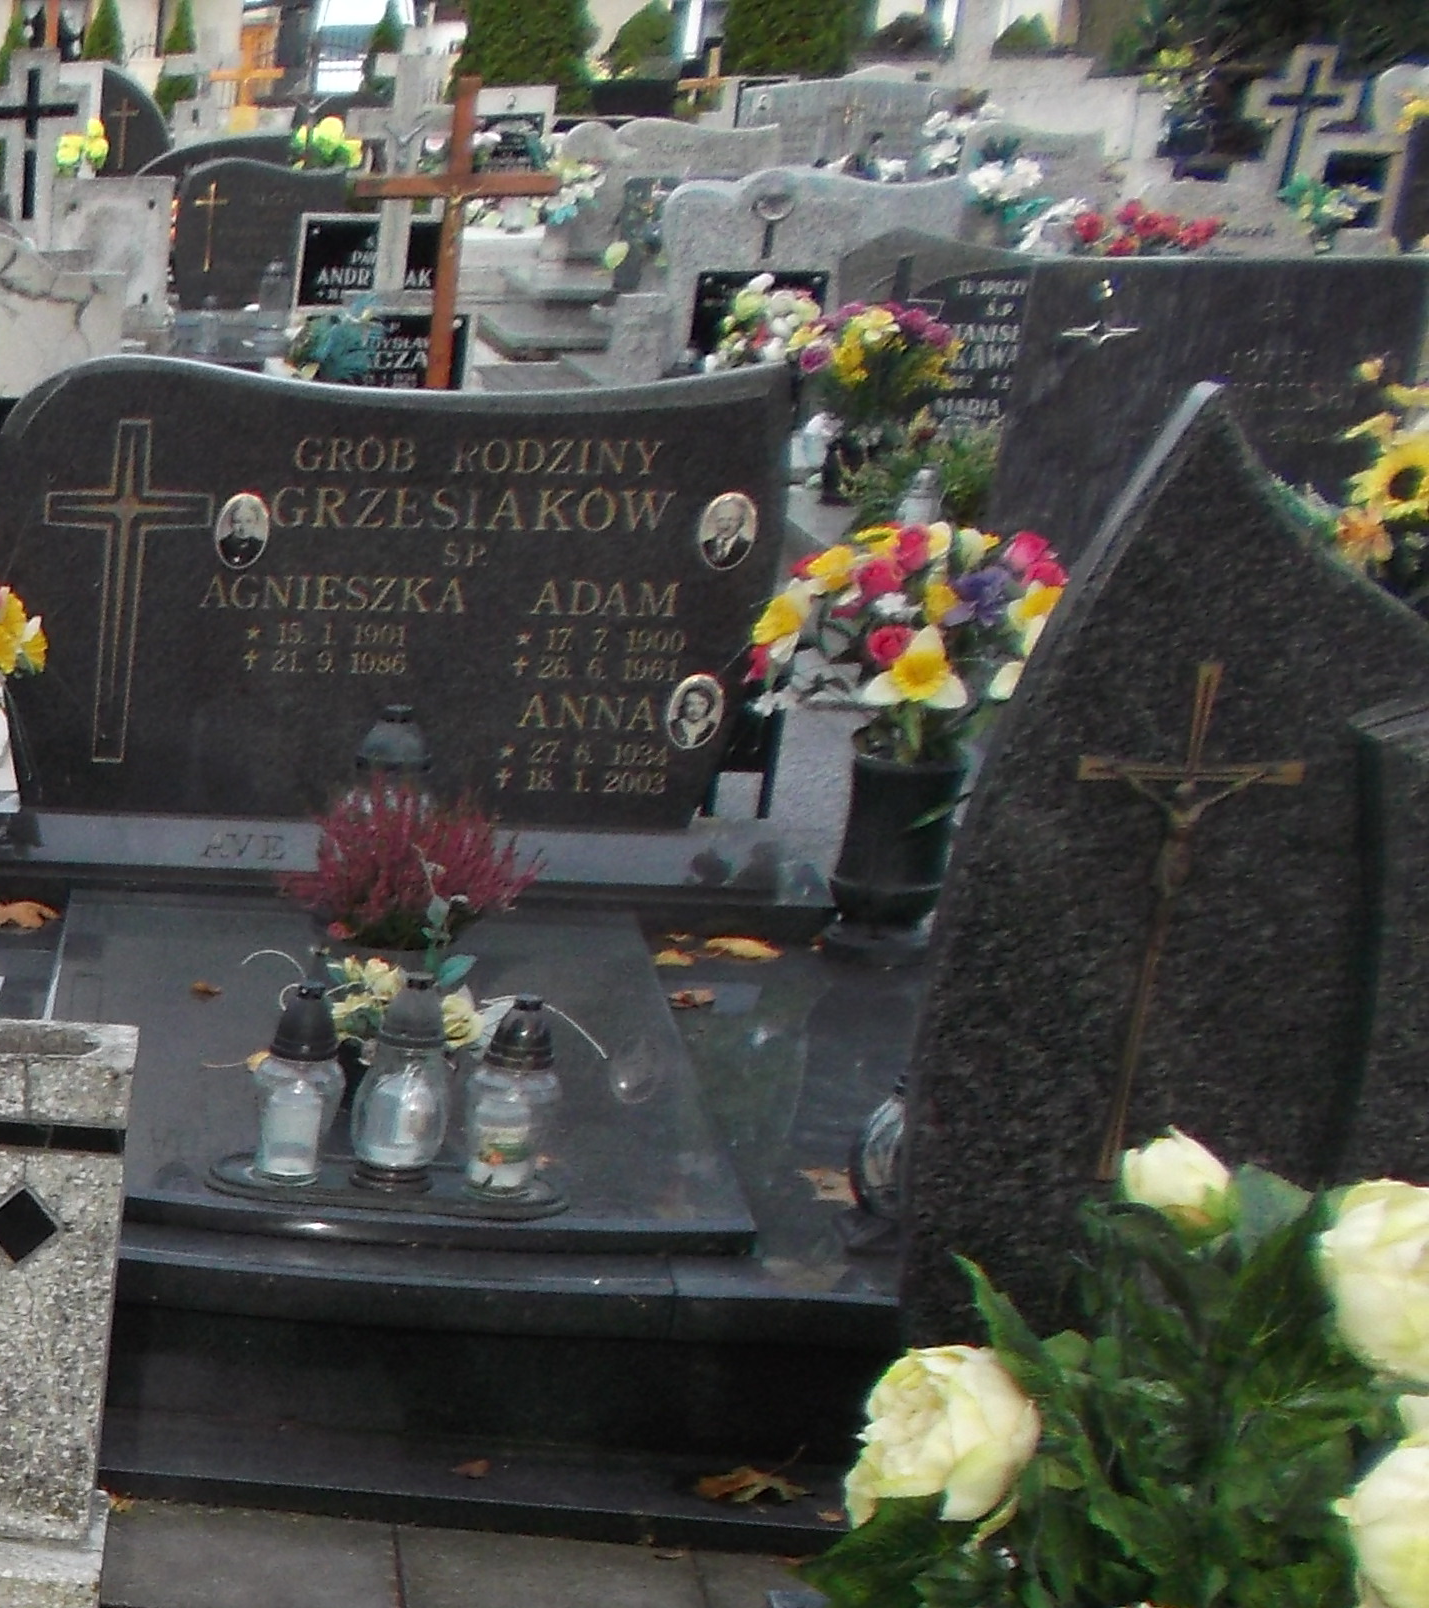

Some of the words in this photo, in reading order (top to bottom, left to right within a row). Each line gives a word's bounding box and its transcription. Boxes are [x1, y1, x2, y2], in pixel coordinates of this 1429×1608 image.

[316, 266, 433, 288] ANDRAK
[452, 437, 664, 475] RODZINY
[198, 573, 468, 615] AGNIESZKA
[528, 579, 682, 618] ADAM
[626, 629, 687, 653] 1900
[516, 693, 657, 732] ANNA
[199, 831, 286, 861] AVE
